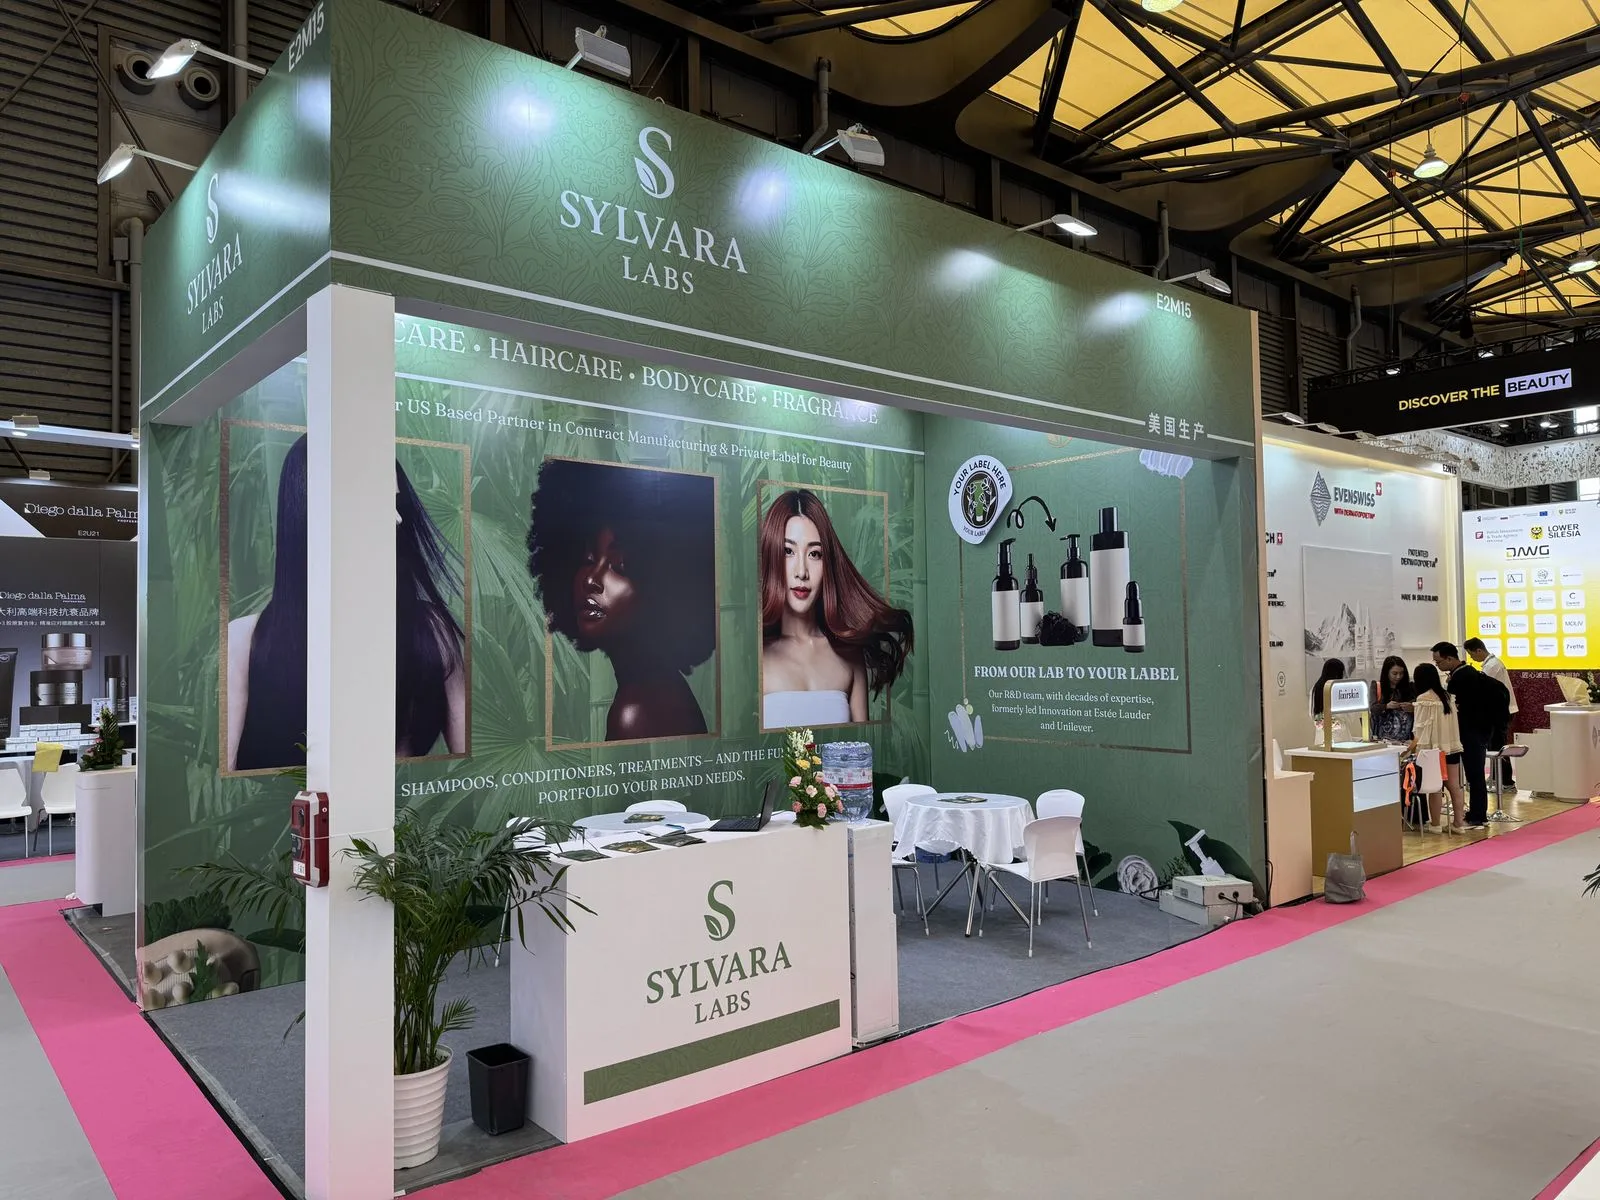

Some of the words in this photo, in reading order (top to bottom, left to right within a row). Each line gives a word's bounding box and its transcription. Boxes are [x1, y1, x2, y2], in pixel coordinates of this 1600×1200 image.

[288, 1, 324, 73] E2M15
[560, 190, 748, 274] SYLVARA
[187, 232, 242, 315] SYLVARA
[622, 255, 694, 294] LABS
[202, 296, 224, 334] LABS
[1156, 293, 1192, 319] E2M15
[489, 337, 623, 382] HAIRCARE
[642, 366, 757, 405] BODYCARE
[772, 390, 879, 424] FRAGRANCE
[1398, 390, 1468, 411] DISCOVER
[1470, 384, 1500, 399] THE
[1507, 372, 1570, 393] BEAUTY
[407, 398, 431, 416] US
[435, 402, 482, 422] Based
[488, 410, 544, 430] Partner
[548, 419, 562, 433] in
[566, 422, 624, 442] Contract
[628, 430, 716, 457] Manufacturing
[720, 444, 728, 454] &
[731, 444, 770, 462] Private
[772, 449, 800, 464] Label
[802, 453, 818, 466] for
[819, 456, 852, 473] Beauty
[1148, 412, 1205, 441] 美国生产
[954, 468, 969, 496] YOUR
[968, 460, 990, 472] LABEL
[992, 466, 1006, 490] HERE
[24, 502, 64, 517] Diego
[67, 506, 104, 518] dalla
[1334, 486, 1376, 508] EVENSWISS
[1548, 523, 1579, 532] LOWER
[1548, 530, 1581, 539] SILESIA
[0, 592, 26, 600] Diego
[28, 591, 53, 600] dalla
[55, 592, 86, 601] Palma
[974, 666, 1008, 678] FROM
[1010, 666, 1036, 678] OUR
[1039, 666, 1064, 679] LAB
[1066, 666, 1085, 679] TO
[1088, 667, 1127, 680] YOUR
[1130, 667, 1179, 681] LABEL
[988, 689, 1003, 699] Our
[1004, 690, 1021, 699] R&D
[1023, 691, 1045, 701] team,
[1046, 691, 1064, 701] with
[1065, 692, 1098, 702] decades
[1100, 692, 1109, 702] of
[1111, 694, 1154, 706] expertise,
[992, 704, 1024, 716] formerly
[1025, 705, 1037, 714] led
[1038, 706, 1082, 716] Innovation
[1084, 709, 1092, 717] at
[1094, 708, 1117, 718] Estée
[1119, 709, 1152, 720] Lauder
[1040, 721, 1055, 730] and
[1057, 721, 1094, 733] Unilever.
[401, 775, 498, 797] SHAMPOOS,
[502, 763, 616, 787] CONDITIONERS,
[618, 754, 702, 774] TREATMENTS
[715, 751, 741, 765] AND
[743, 749, 765, 762] THE
[538, 782, 619, 804] PORTFOLIO
[622, 779, 658, 794] YOUR
[661, 774, 703, 790] BRAND
[705, 770, 746, 786] NEEDS.
[646, 941, 792, 1004] SYLVARA
[694, 990, 751, 1024] LABS
